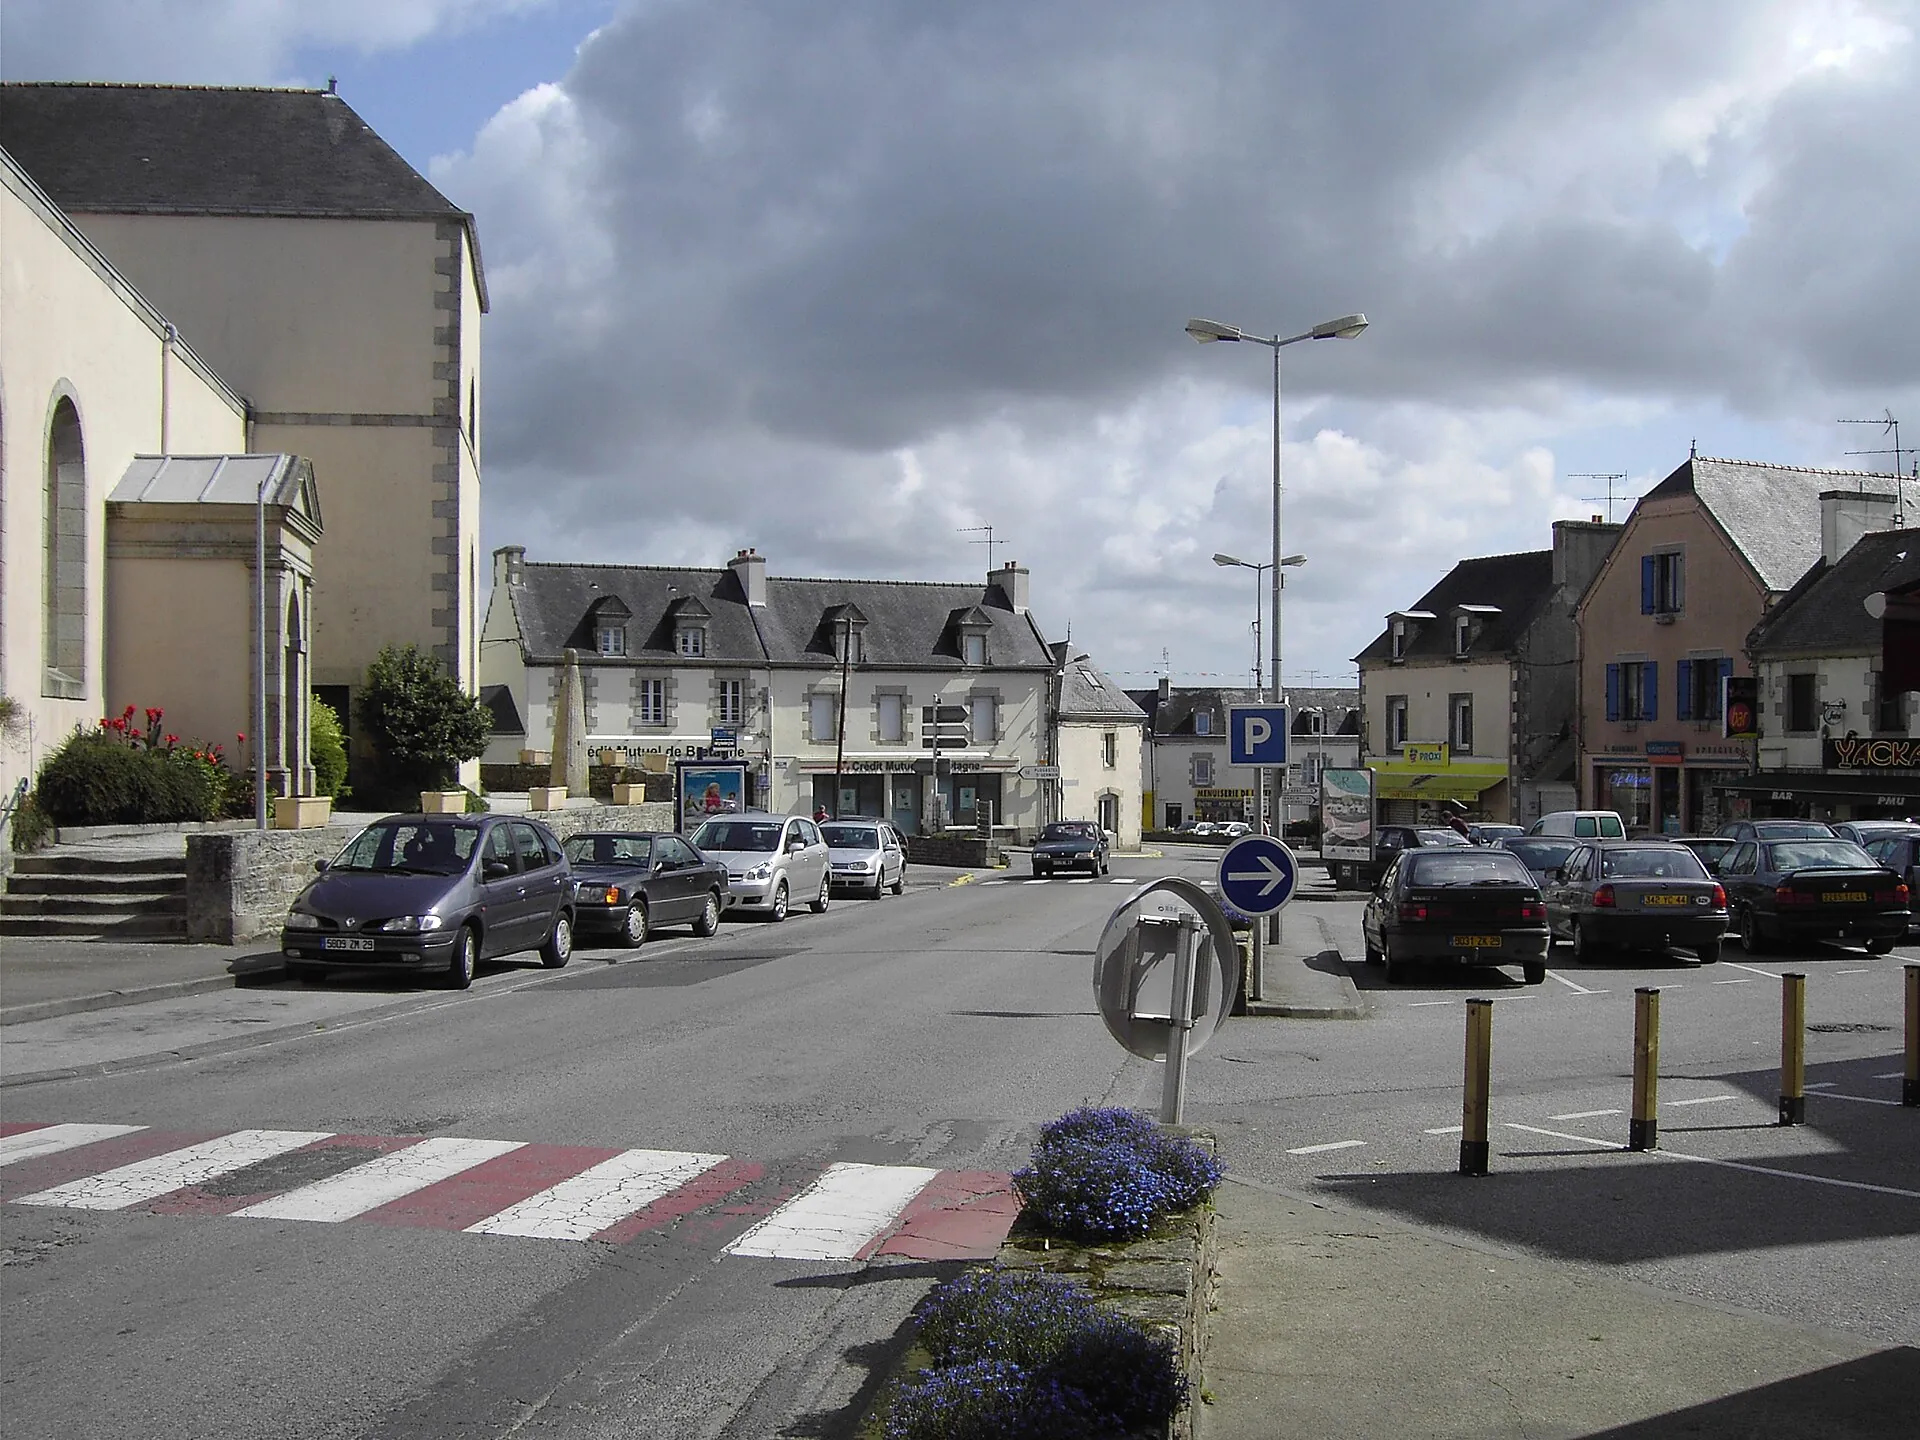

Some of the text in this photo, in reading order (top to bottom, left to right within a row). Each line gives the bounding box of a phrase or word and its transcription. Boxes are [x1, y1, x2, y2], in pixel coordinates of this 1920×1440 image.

[1731, 709, 1749, 728] bar
[1244, 717, 1272, 755] P
[665, 745, 681, 757] de
[686, 745, 745, 760] Betagne
[1419, 752, 1442, 761] PROXI
[852, 761, 882, 771] Crédit
[1196, 789, 1239, 798] MENUISERIE
[1771, 791, 1793, 800] BAR
[1876, 796, 1906, 806] PMU
[362, 940, 373, 950] 29
